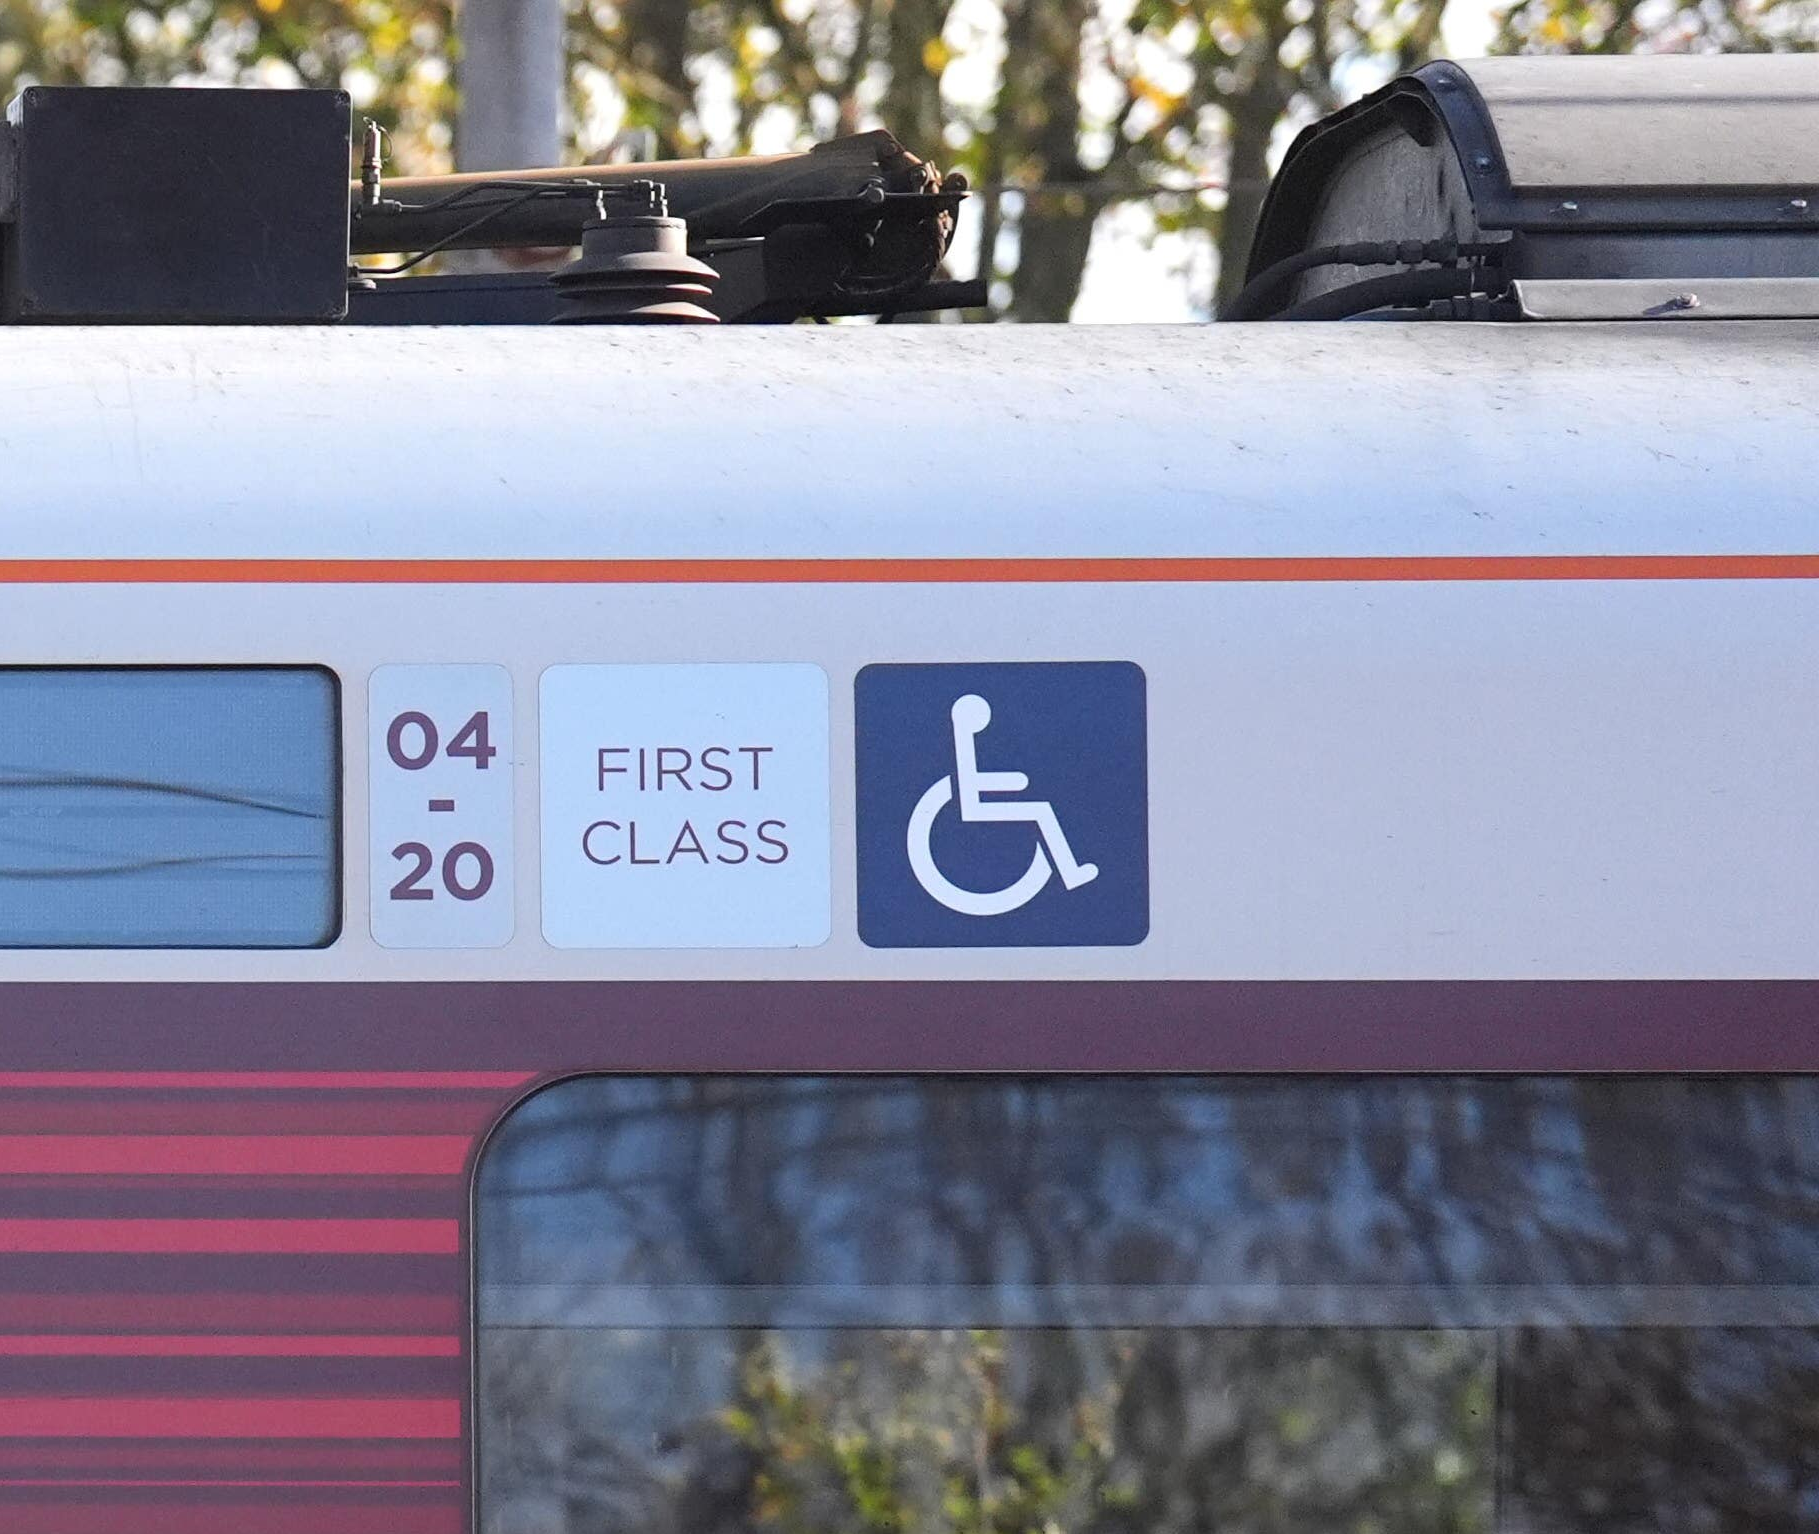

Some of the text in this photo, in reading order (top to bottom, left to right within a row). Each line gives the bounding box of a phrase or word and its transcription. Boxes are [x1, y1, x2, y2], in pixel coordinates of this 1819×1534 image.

[387, 711, 496, 770] 04
[599, 747, 773, 791] FIRST
[583, 820, 788, 865] CLASS
[390, 842, 494, 901] 20
